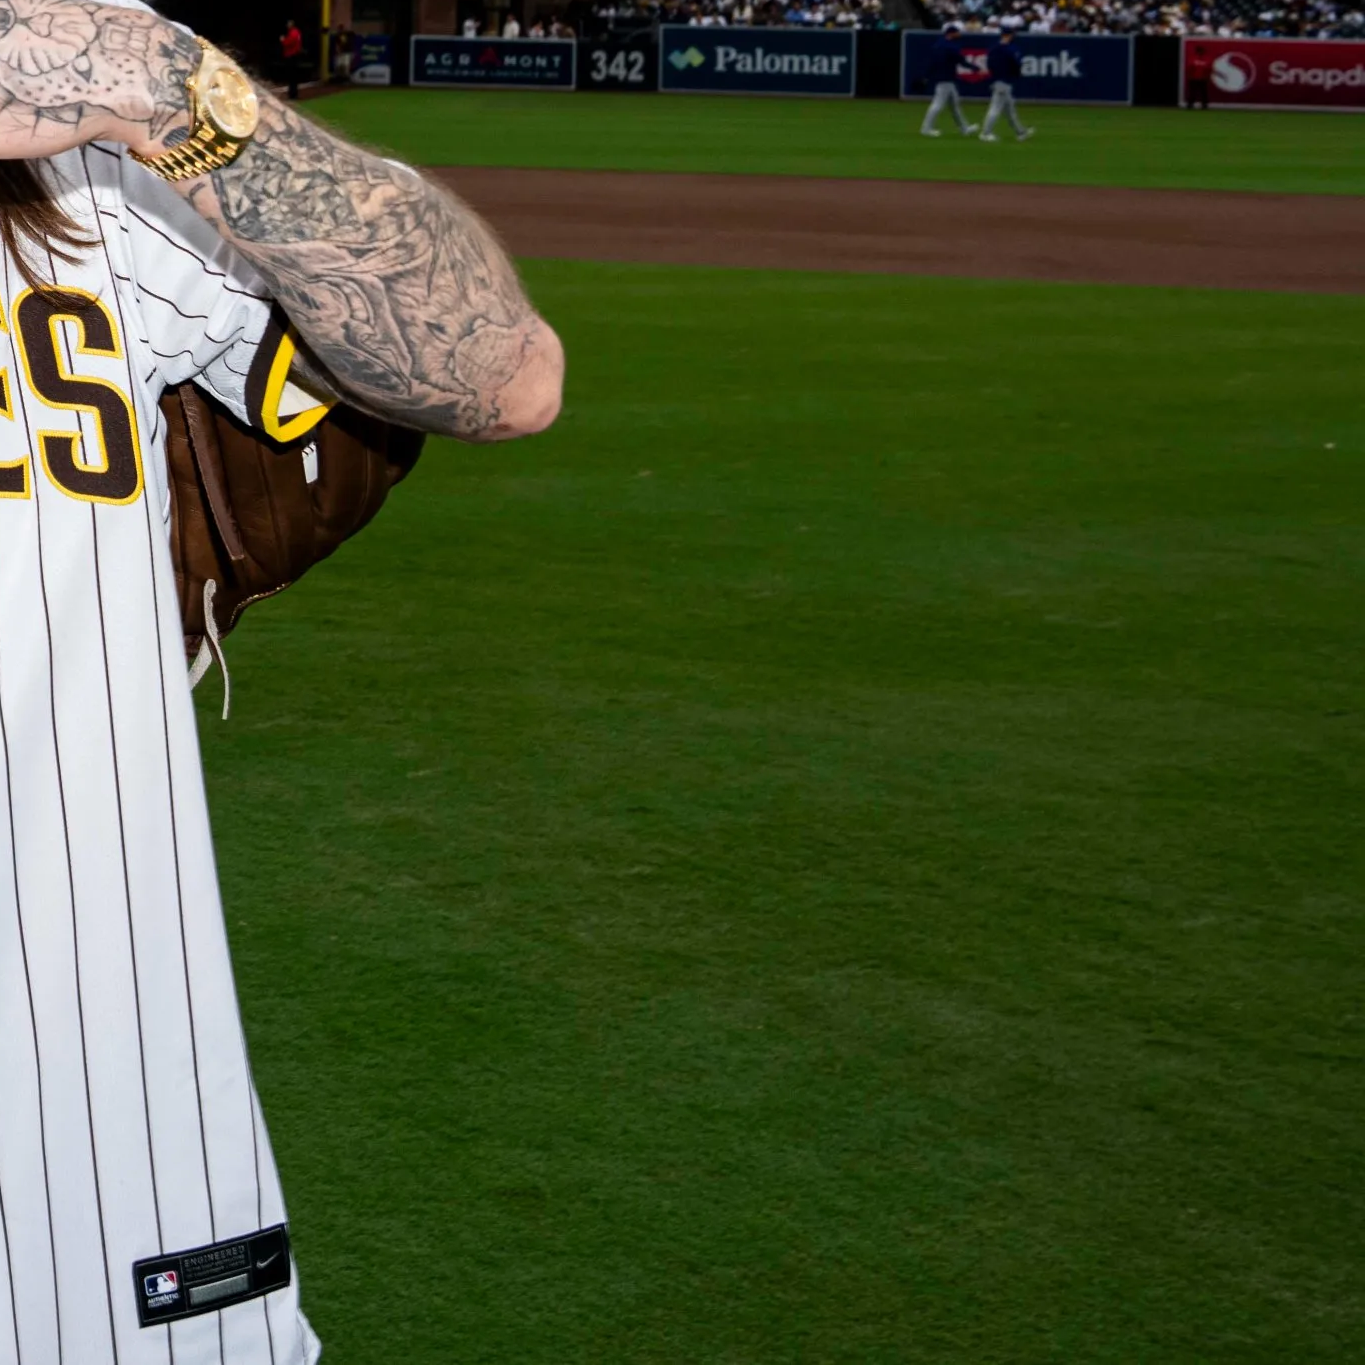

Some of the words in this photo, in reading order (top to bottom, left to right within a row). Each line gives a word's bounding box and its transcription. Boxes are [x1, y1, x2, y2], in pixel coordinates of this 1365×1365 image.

[590, 50, 645, 82] 342
[713, 45, 847, 75] Palomar
[1020, 49, 1082, 78] ank
[183, 1245, 247, 1268] ENGINEERED
